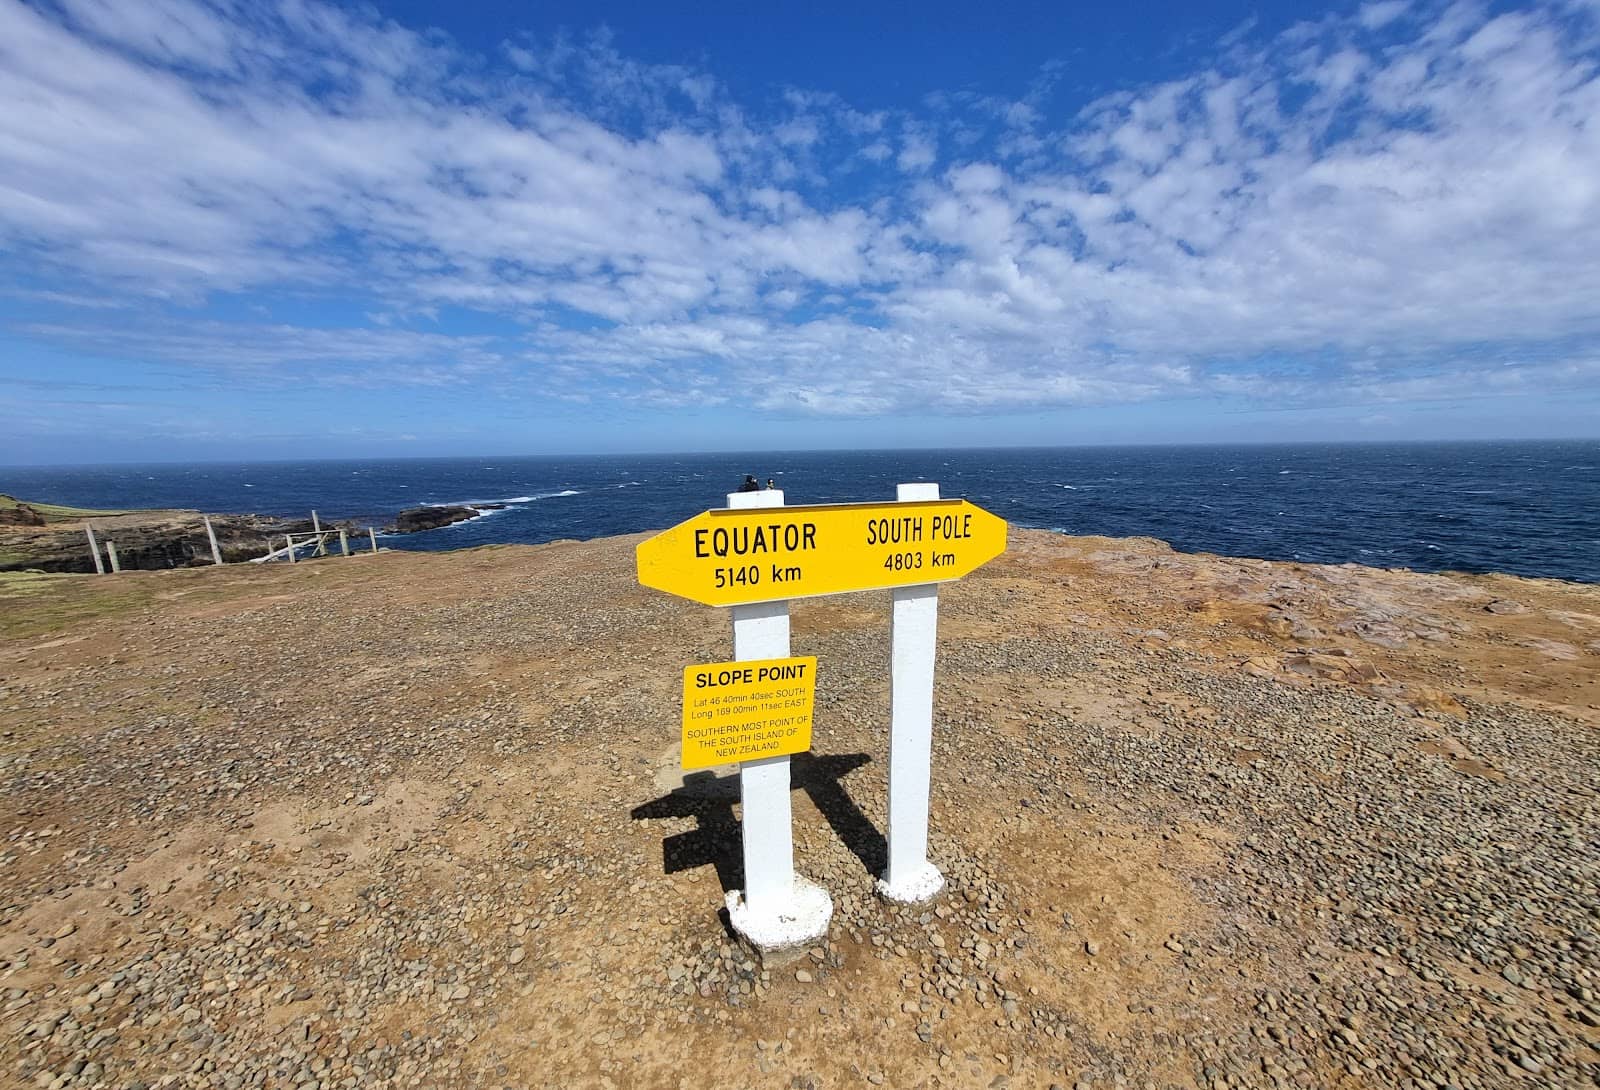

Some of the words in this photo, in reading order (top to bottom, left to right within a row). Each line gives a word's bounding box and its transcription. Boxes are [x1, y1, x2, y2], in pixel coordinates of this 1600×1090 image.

[695, 523, 816, 558] EQUATOR
[867, 517, 922, 545] SOUTH
[933, 515, 972, 540] POLE
[884, 551, 922, 572] 4803
[933, 551, 955, 567] km
[715, 565, 760, 588] 5140
[773, 565, 801, 583] km
[696, 669, 752, 688] SLOPE
[758, 665, 806, 682] POINT
[692, 711, 712, 719] Long
[716, 708, 730, 716] 169
[733, 706, 757, 714] 00min
[761, 703, 782, 711] 11sec
[785, 699, 806, 708] EAST
[694, 698, 707, 708] Lat
[710, 697, 720, 705] 46
[723, 695, 747, 703] 40min
[751, 692, 773, 700] 40sec
[776, 688, 806, 698] SOUTH
[688, 725, 739, 739] SOUTHERN
[742, 722, 766, 732] MOST
[770, 718, 795, 727] POINT
[797, 716, 808, 724] OF
[698, 740, 717, 749] THE
[720, 736, 750, 746] SOUTH
[754, 730, 784, 740] ISLAND
[786, 728, 798, 736] OF
[716, 748, 736, 757] NEW
[739, 742, 780, 754] ZEALAND
